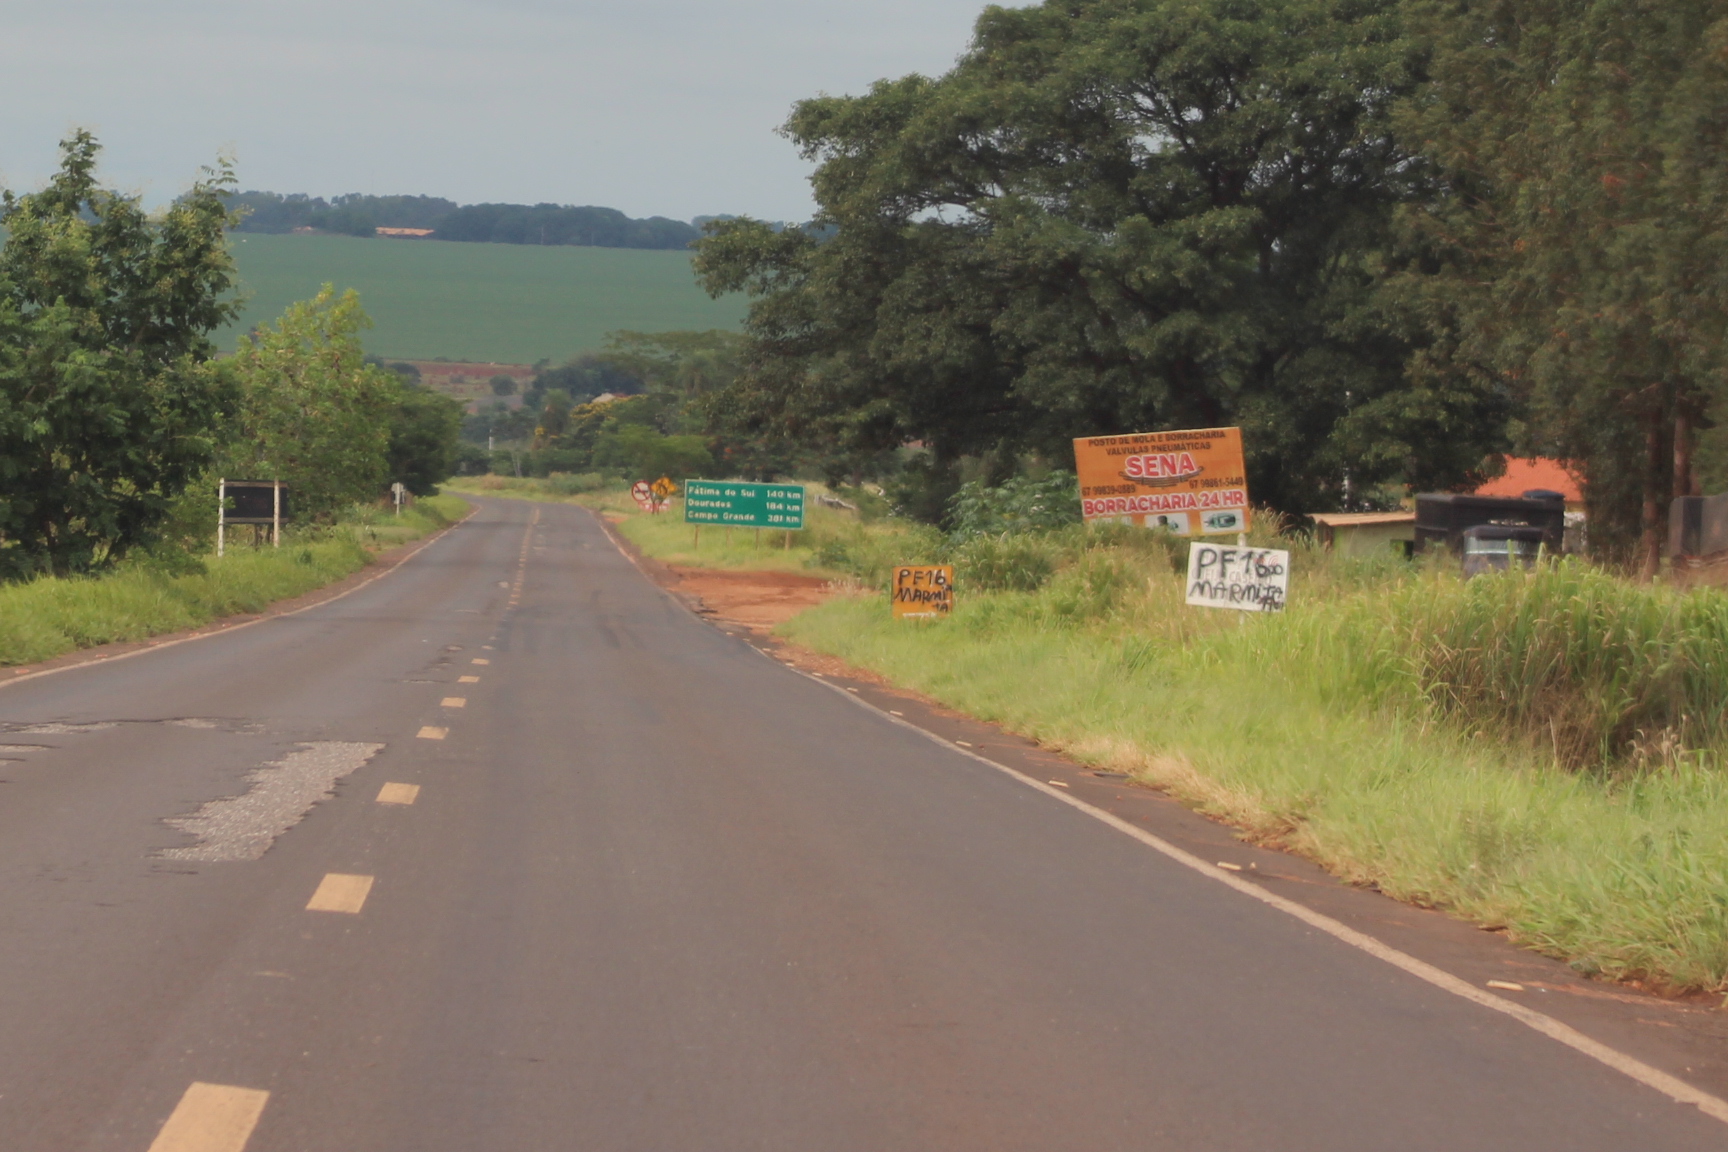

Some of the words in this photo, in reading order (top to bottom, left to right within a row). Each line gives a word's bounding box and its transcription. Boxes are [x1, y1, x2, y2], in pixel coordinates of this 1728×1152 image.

[1088, 437, 1116, 447] POSTO
[1119, 437, 1130, 445] DE
[1132, 435, 1156, 444] MOLA
[1158, 434, 1163, 442] E
[1165, 431, 1226, 441] BORRACHARIA
[1151, 442, 1211, 453] PNEUMÁTICAS
[1125, 452, 1197, 478] SENA
[688, 485, 720, 495] Fátima
[724, 488, 736, 496] do
[740, 489, 755, 497] Sul
[766, 489, 784, 498] 140
[787, 491, 801, 499] km
[688, 498, 732, 508] Dourados
[766, 501, 783, 510] 184
[787, 503, 800, 511] km
[1083, 494, 1197, 515] BORRACHARIA
[1199, 492, 1220, 508] 24
[1221, 490, 1246, 506] HR
[688, 511, 718, 520] Campo
[722, 512, 755, 521] Grande
[786, 515, 799, 523] km
